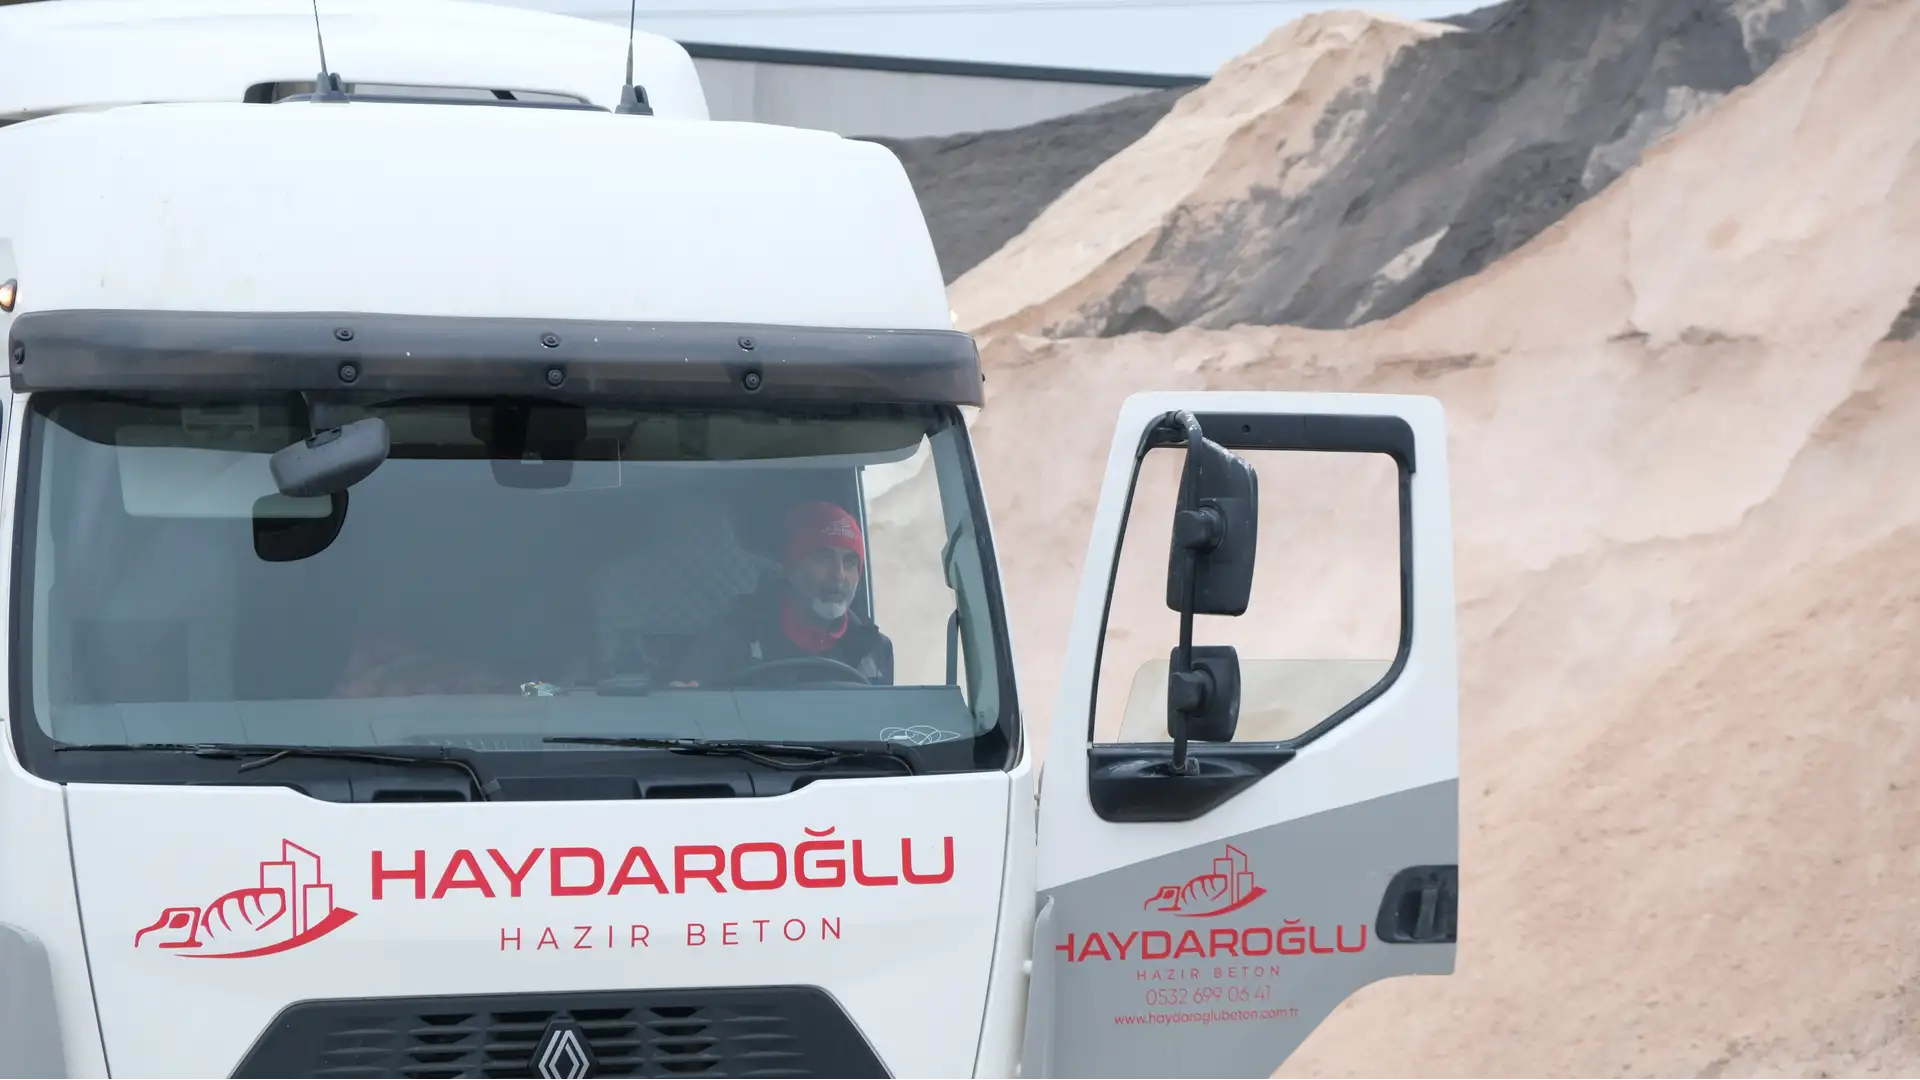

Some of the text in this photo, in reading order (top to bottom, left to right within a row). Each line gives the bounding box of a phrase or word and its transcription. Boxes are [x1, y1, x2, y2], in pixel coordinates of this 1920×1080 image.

[371, 826, 955, 900] HAYDAROĞLU
[501, 917, 842, 951] HAZIR BETON
[1055, 918, 1367, 962] HAYDAROĞLU
[1136, 965, 1281, 981] HAZIR BETON
[1145, 984, 1272, 1006] 0532 699 06 41
[1113, 1006, 1299, 1026] www.haydaroglubeton.comtr
